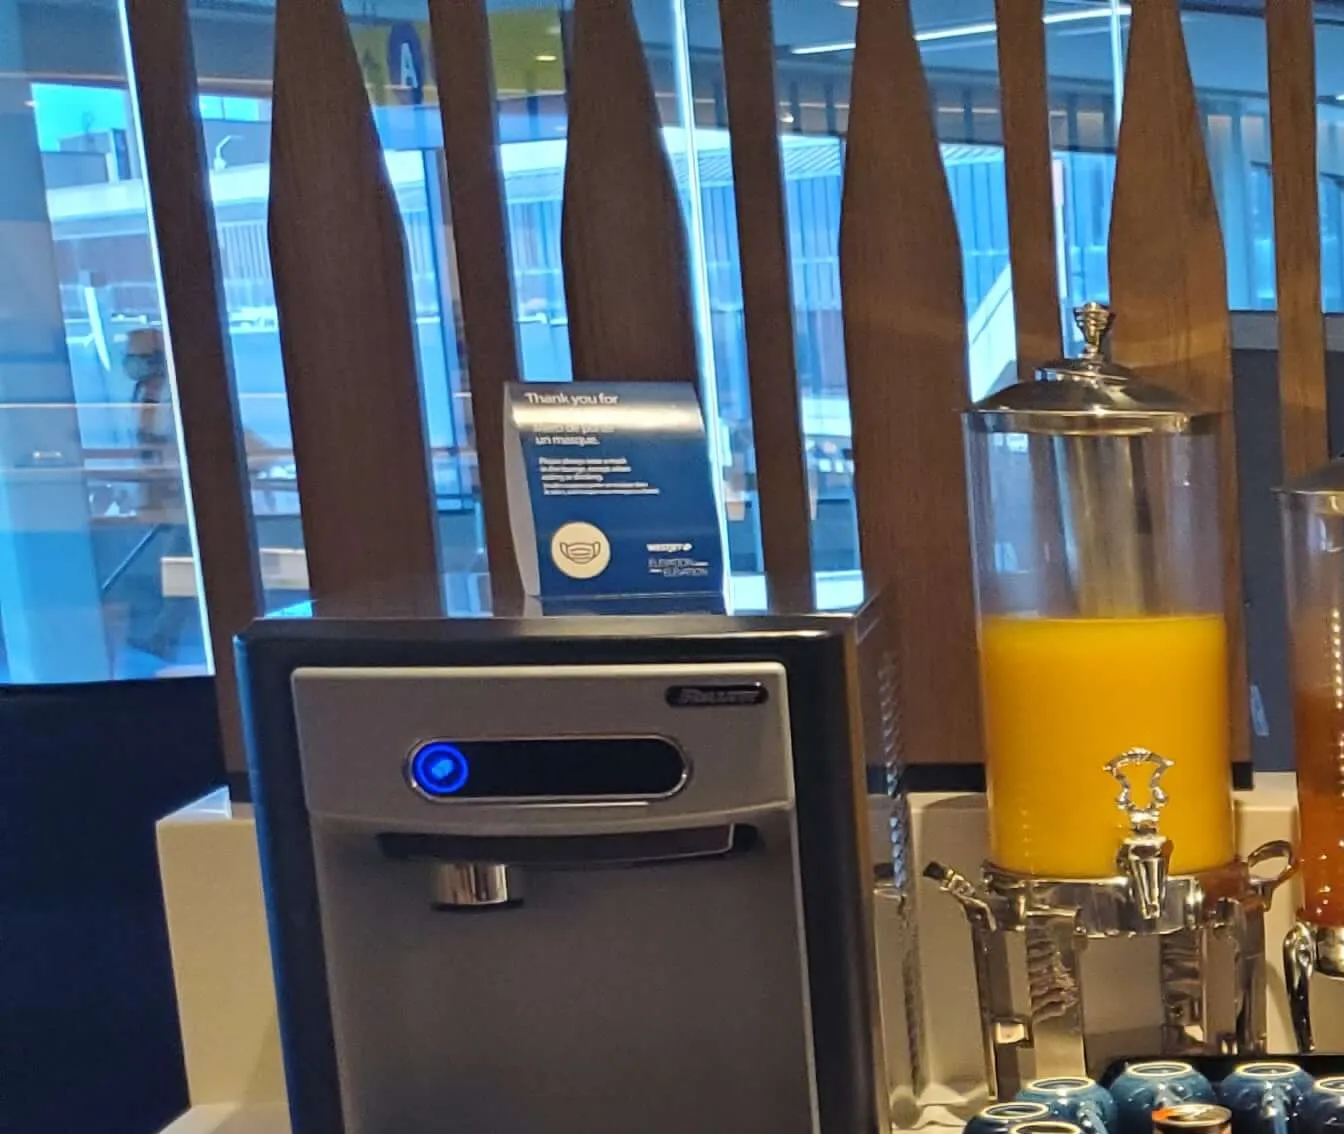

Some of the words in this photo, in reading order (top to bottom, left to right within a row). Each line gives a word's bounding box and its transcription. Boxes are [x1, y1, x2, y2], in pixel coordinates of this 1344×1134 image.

[524, 392, 569, 404] Thank
[572, 394, 597, 406] you
[599, 393, 619, 404] for
